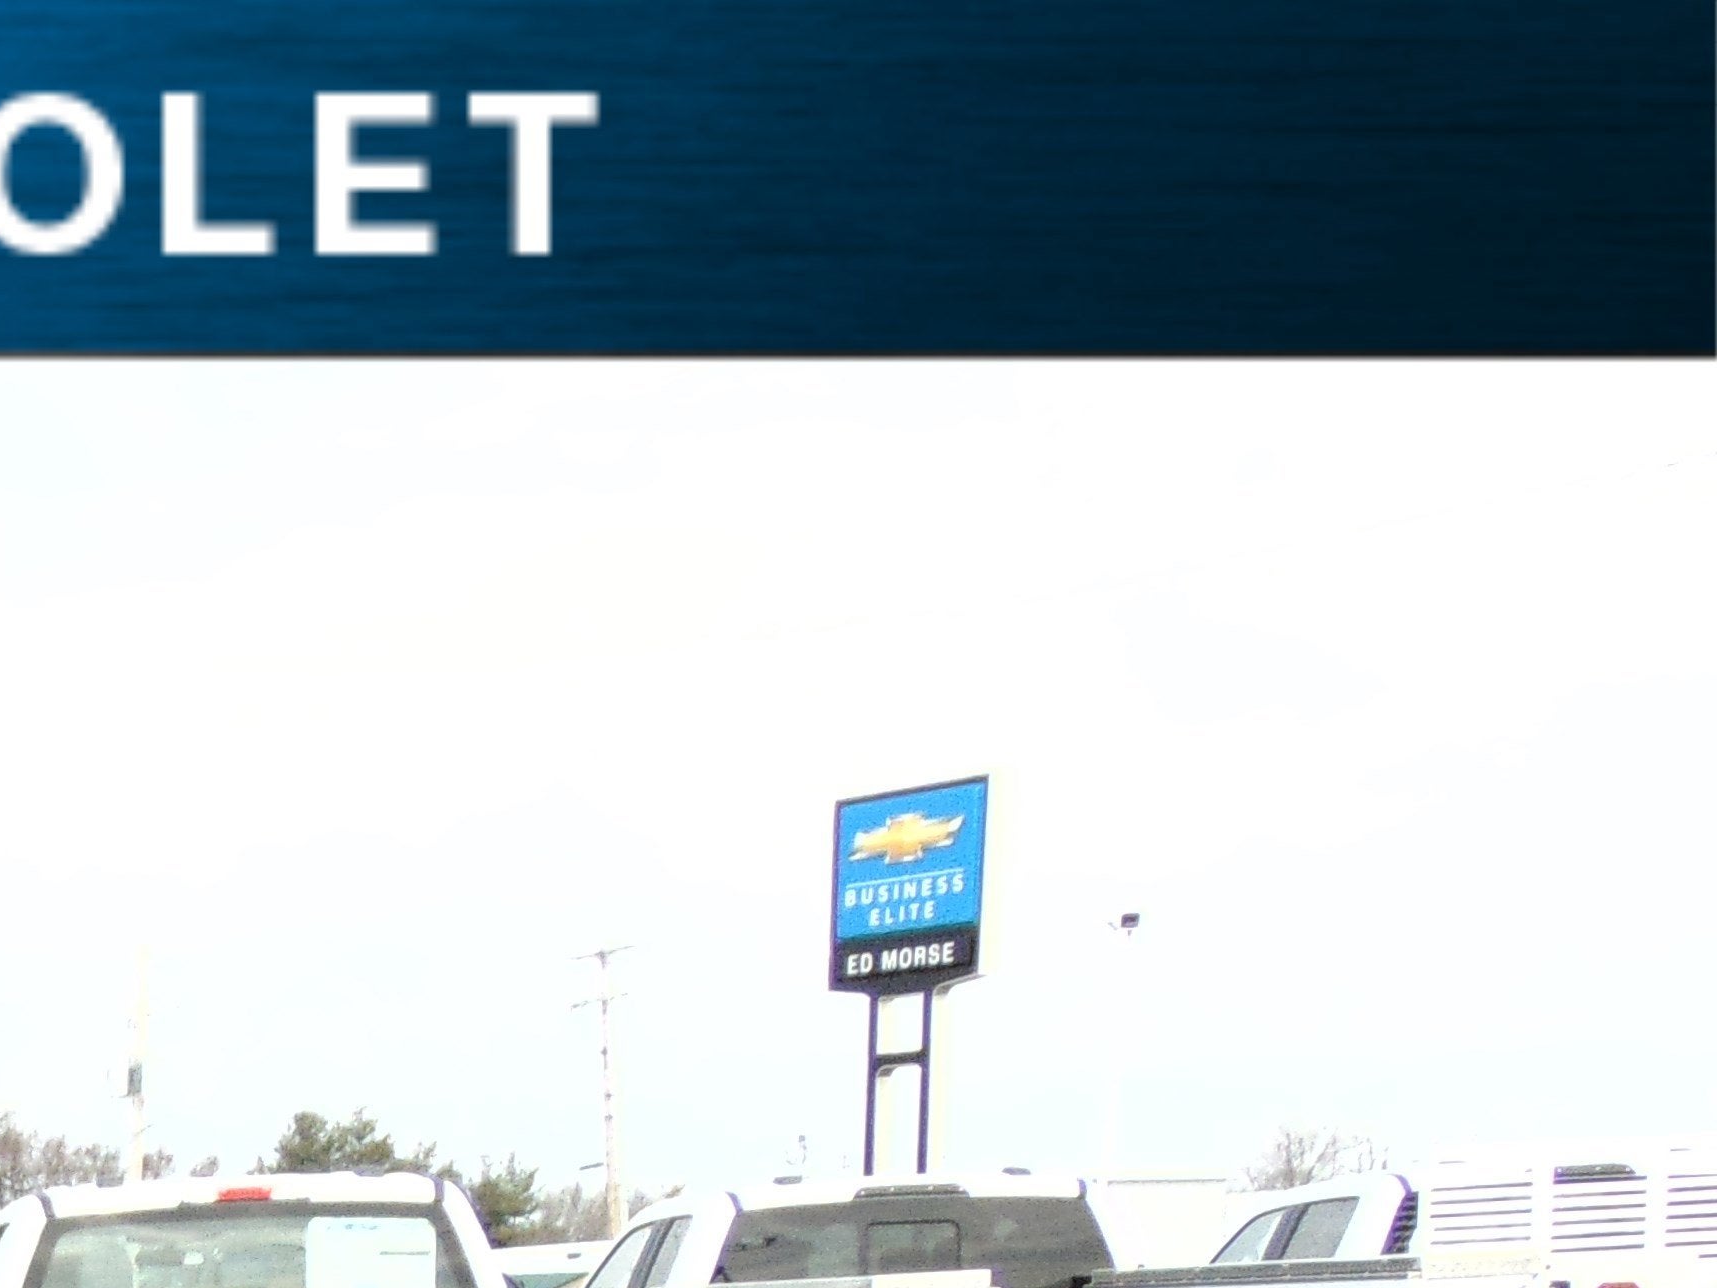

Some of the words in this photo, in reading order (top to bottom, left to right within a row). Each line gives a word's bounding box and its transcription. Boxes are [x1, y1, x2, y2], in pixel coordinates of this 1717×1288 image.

[844, 873, 965, 908] BUSINESS
[869, 900, 935, 927] ELITE
[846, 952, 873, 976] ED
[880, 941, 956, 971] MORSE
